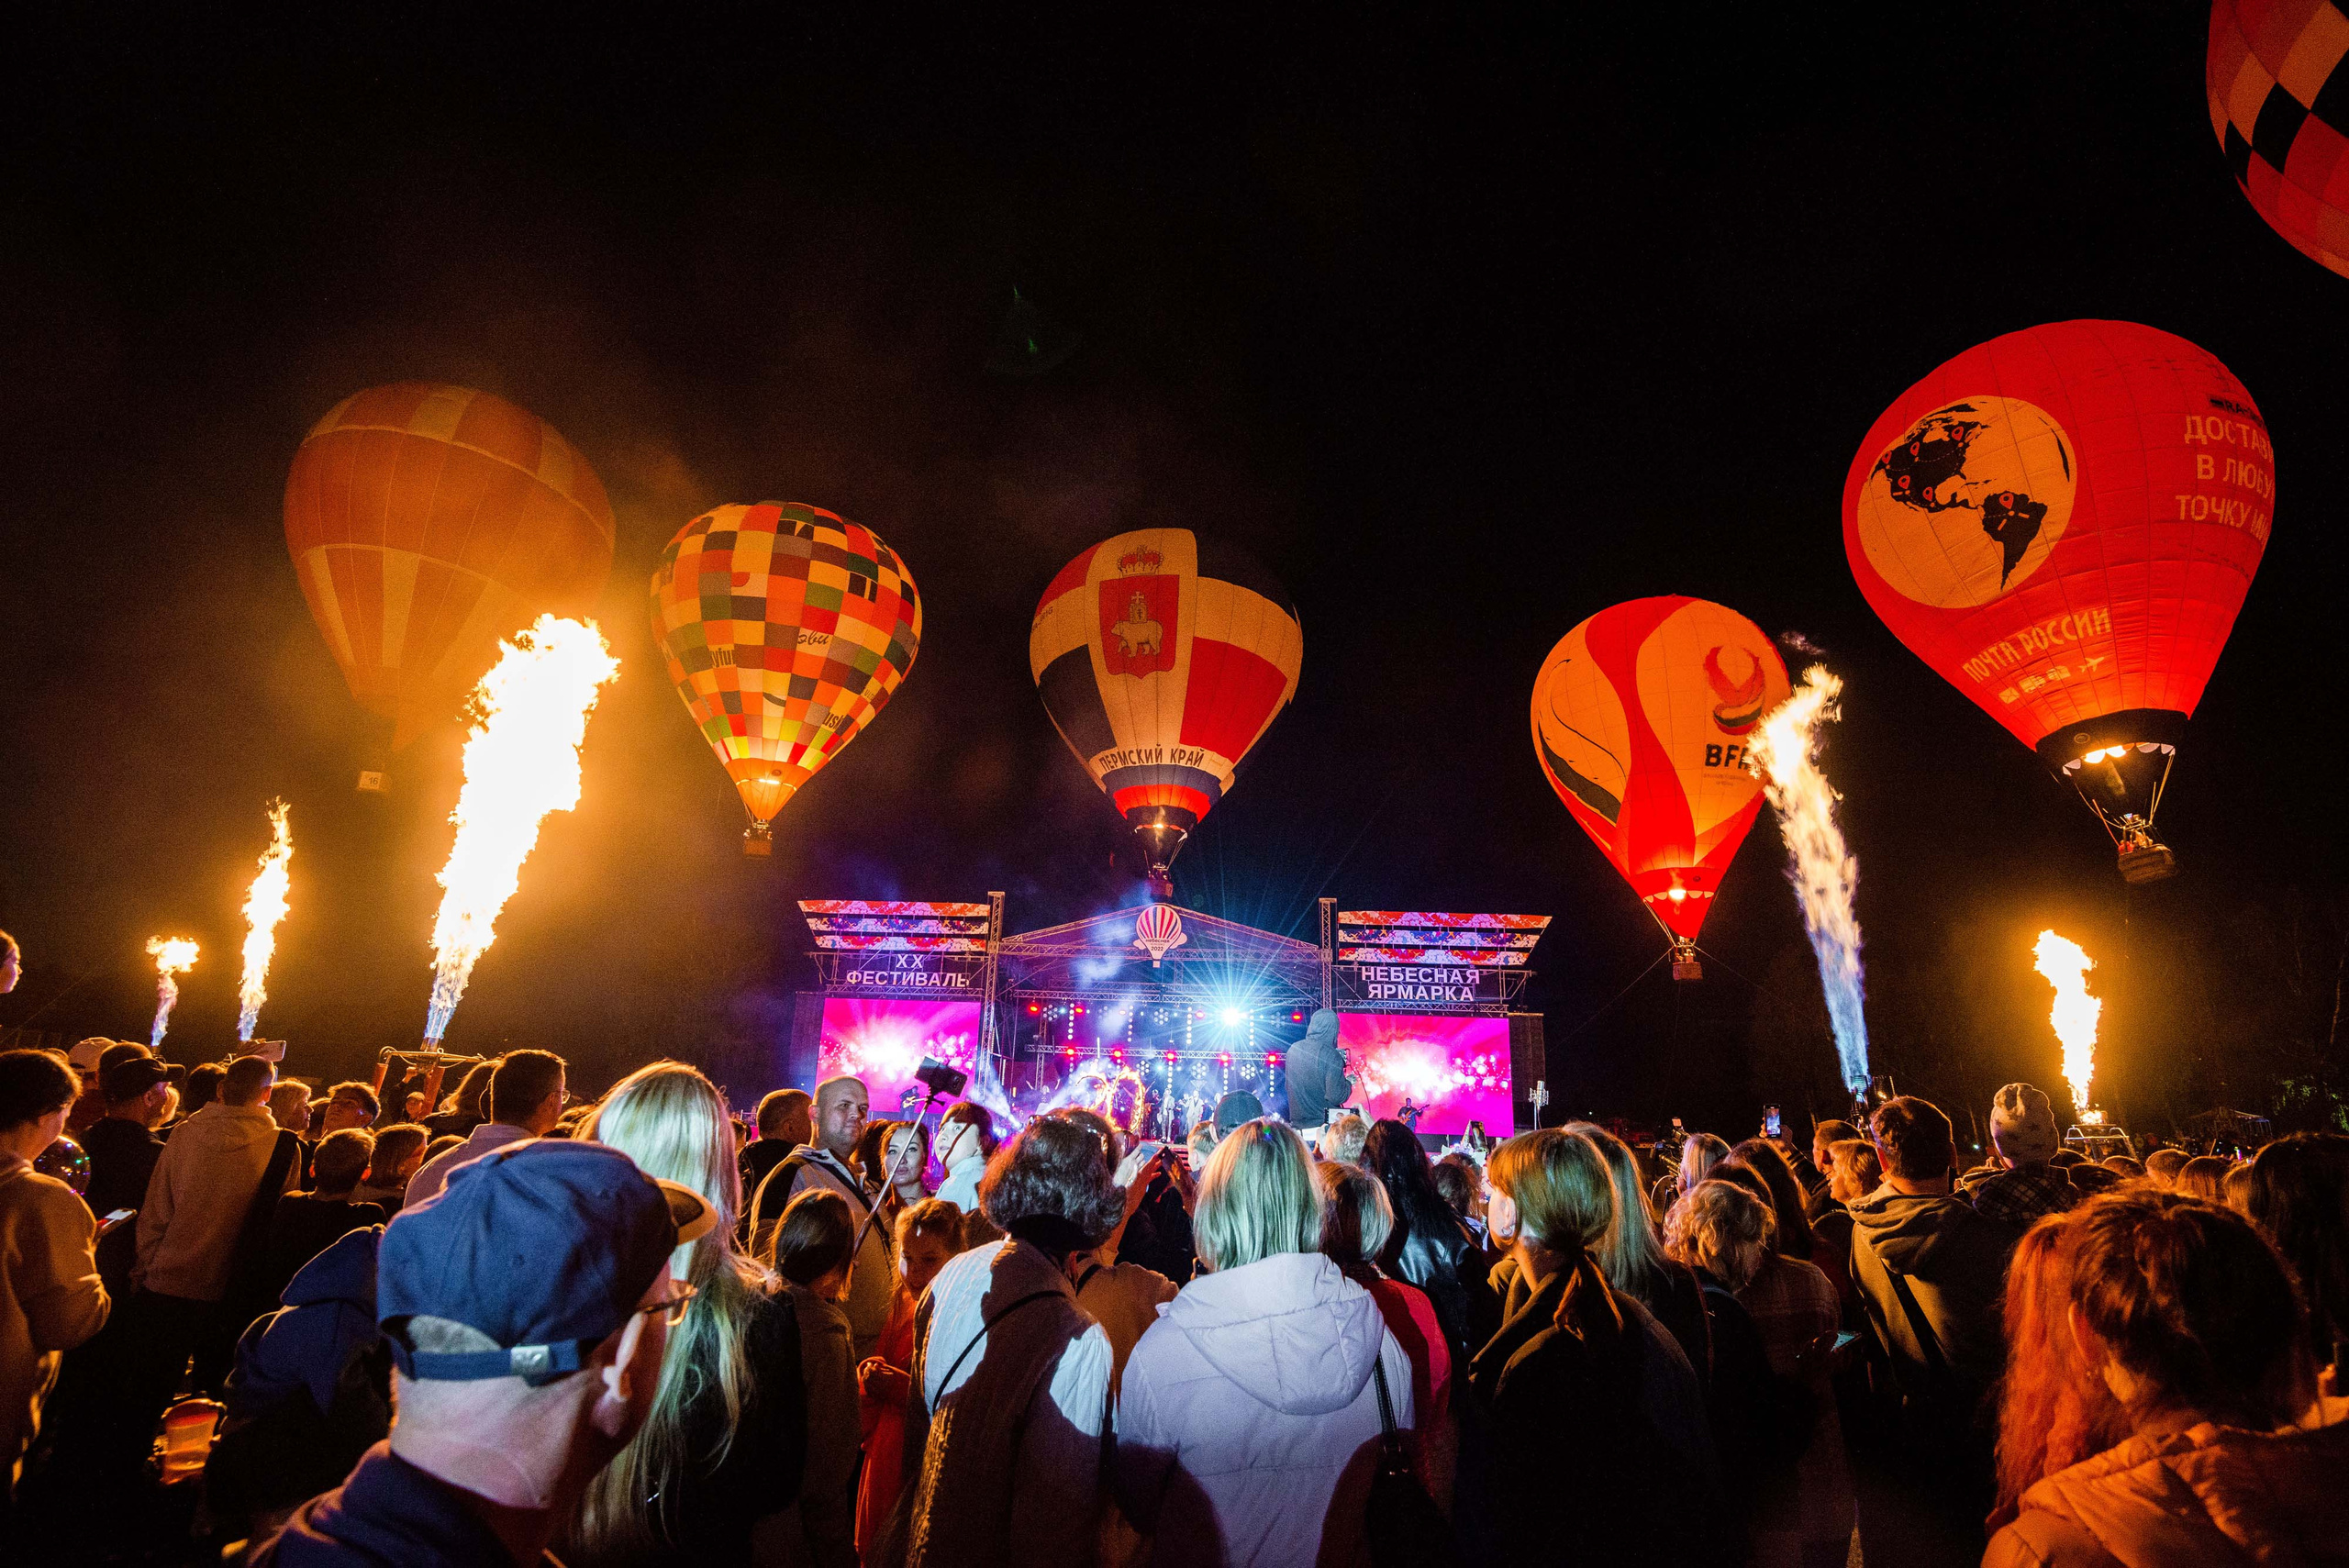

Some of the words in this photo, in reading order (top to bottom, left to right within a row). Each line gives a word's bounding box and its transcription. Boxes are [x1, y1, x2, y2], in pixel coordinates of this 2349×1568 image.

[2196, 454, 2215, 480] В
[2175, 495, 2252, 528] ТОЧКУ
[1962, 640, 2021, 684] ПОЧТА
[2017, 607, 2111, 656] РОССИИ
[1098, 743, 1163, 772] ПЕРМСКИЙ
[1170, 748, 1205, 768] КРАЙ
[846, 970, 970, 987] ФЕСТИВАЛЬ
[1362, 966, 1480, 984] НЕБЕСНАЯ
[1368, 984, 1475, 1001] ЯРМАРКА
